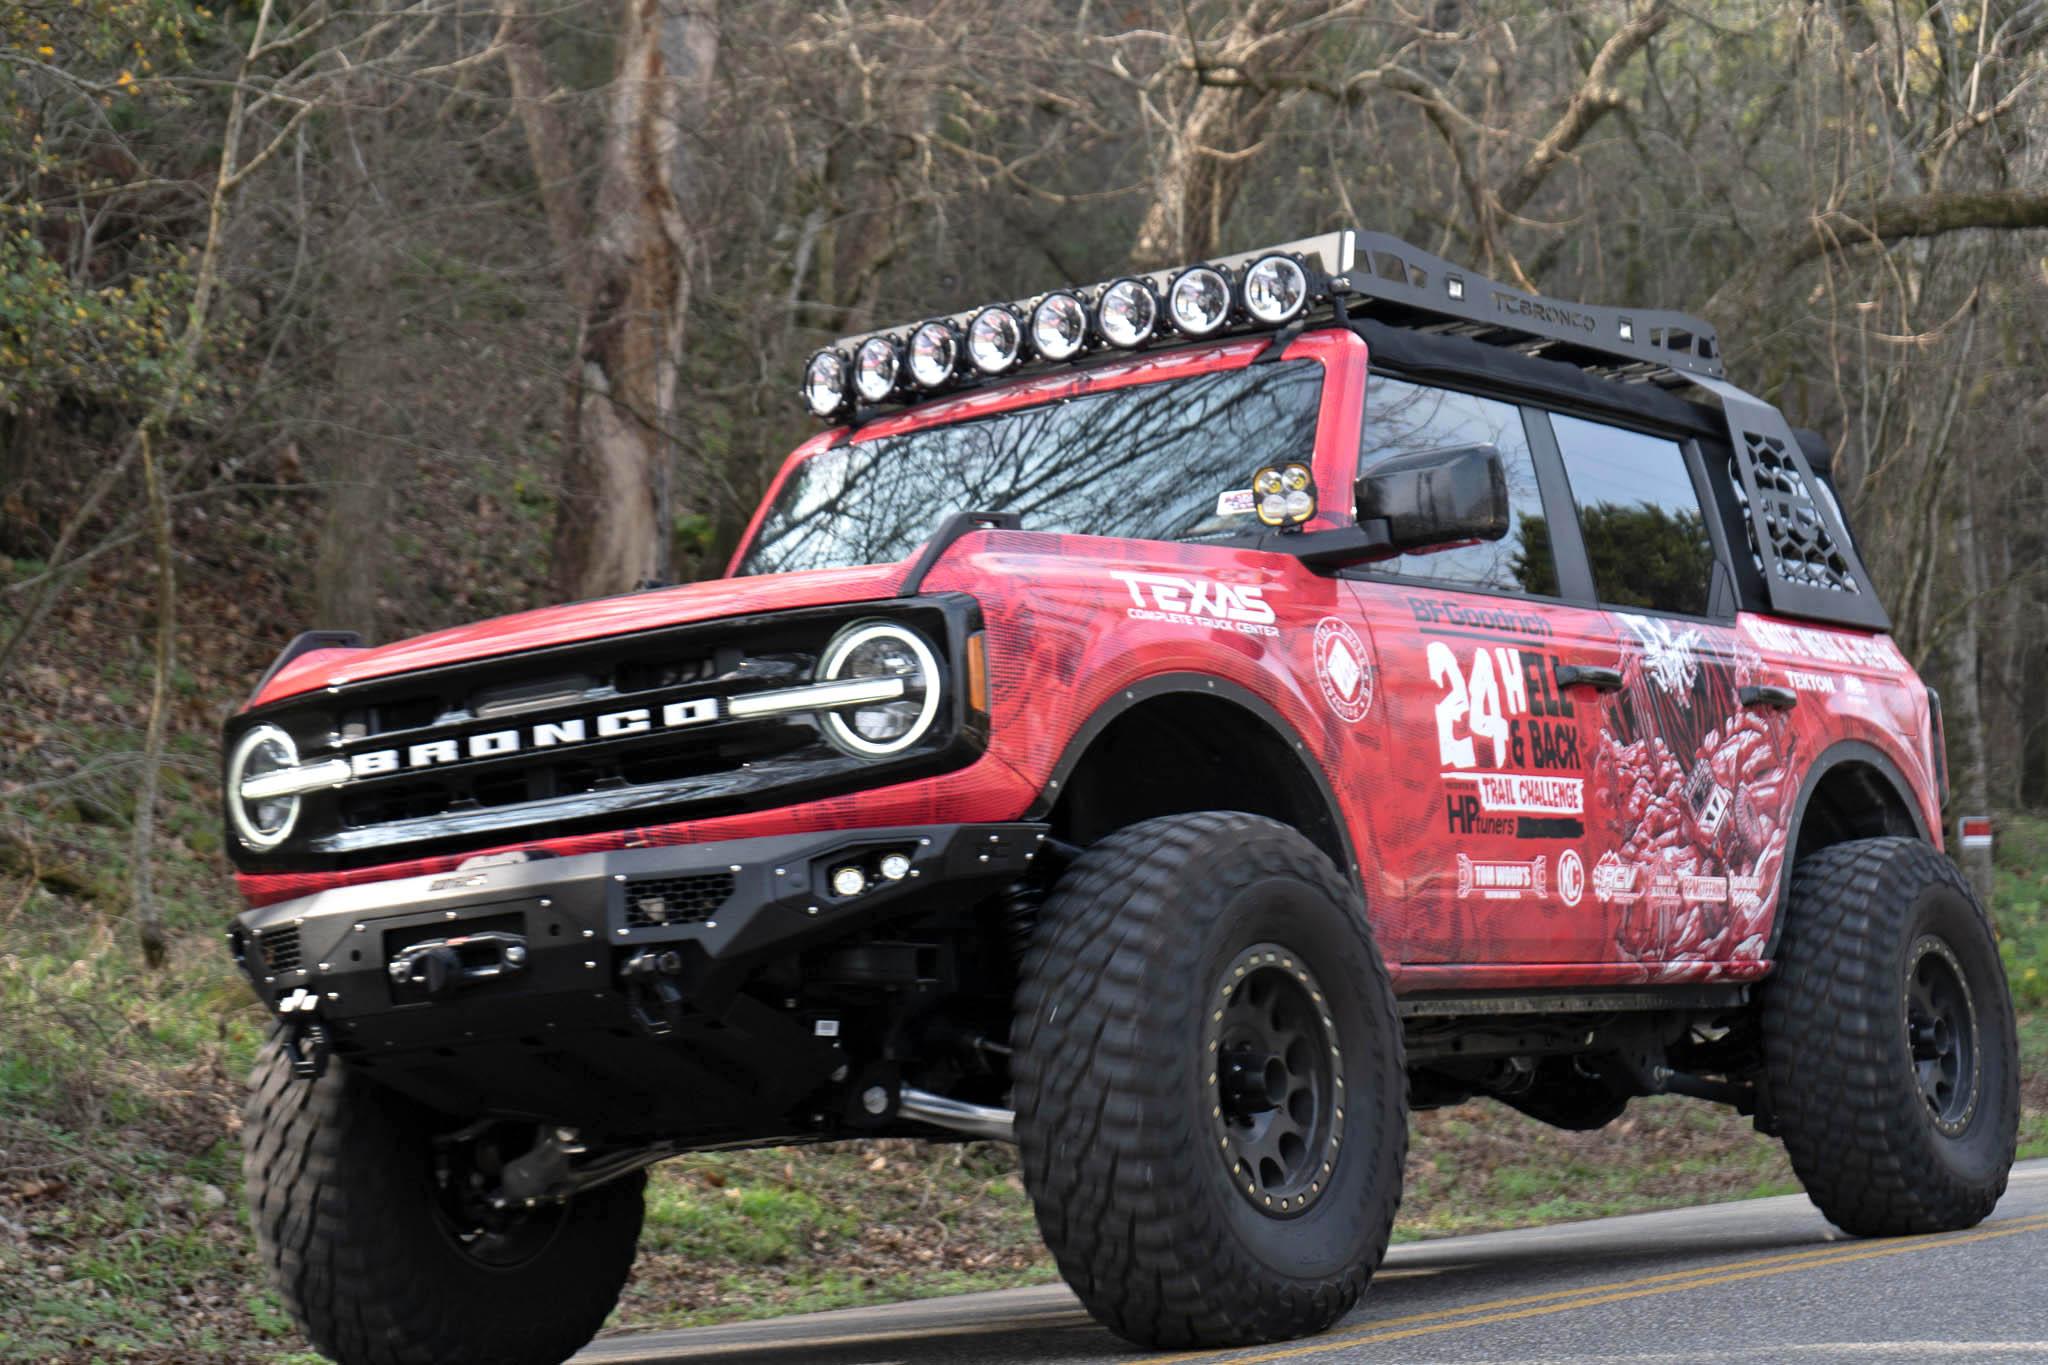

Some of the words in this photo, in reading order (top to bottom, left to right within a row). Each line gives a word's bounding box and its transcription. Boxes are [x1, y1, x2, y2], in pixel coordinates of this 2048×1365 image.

[1110, 570, 1276, 624] TEXAS
[1408, 597, 1553, 636] BFGoodrich
[1127, 608, 1195, 625] COMPLETE
[1195, 616, 1234, 631] TRUCK
[1235, 622, 1281, 637] CENTER
[1785, 670, 1836, 693] TEKTON
[1427, 641, 1509, 769] 24
[351, 698, 719, 777] BRONCO
[1528, 720, 1581, 769] BACK
[1482, 778, 1516, 805] TRAIL
[1519, 780, 1579, 809] CHALLENGE
